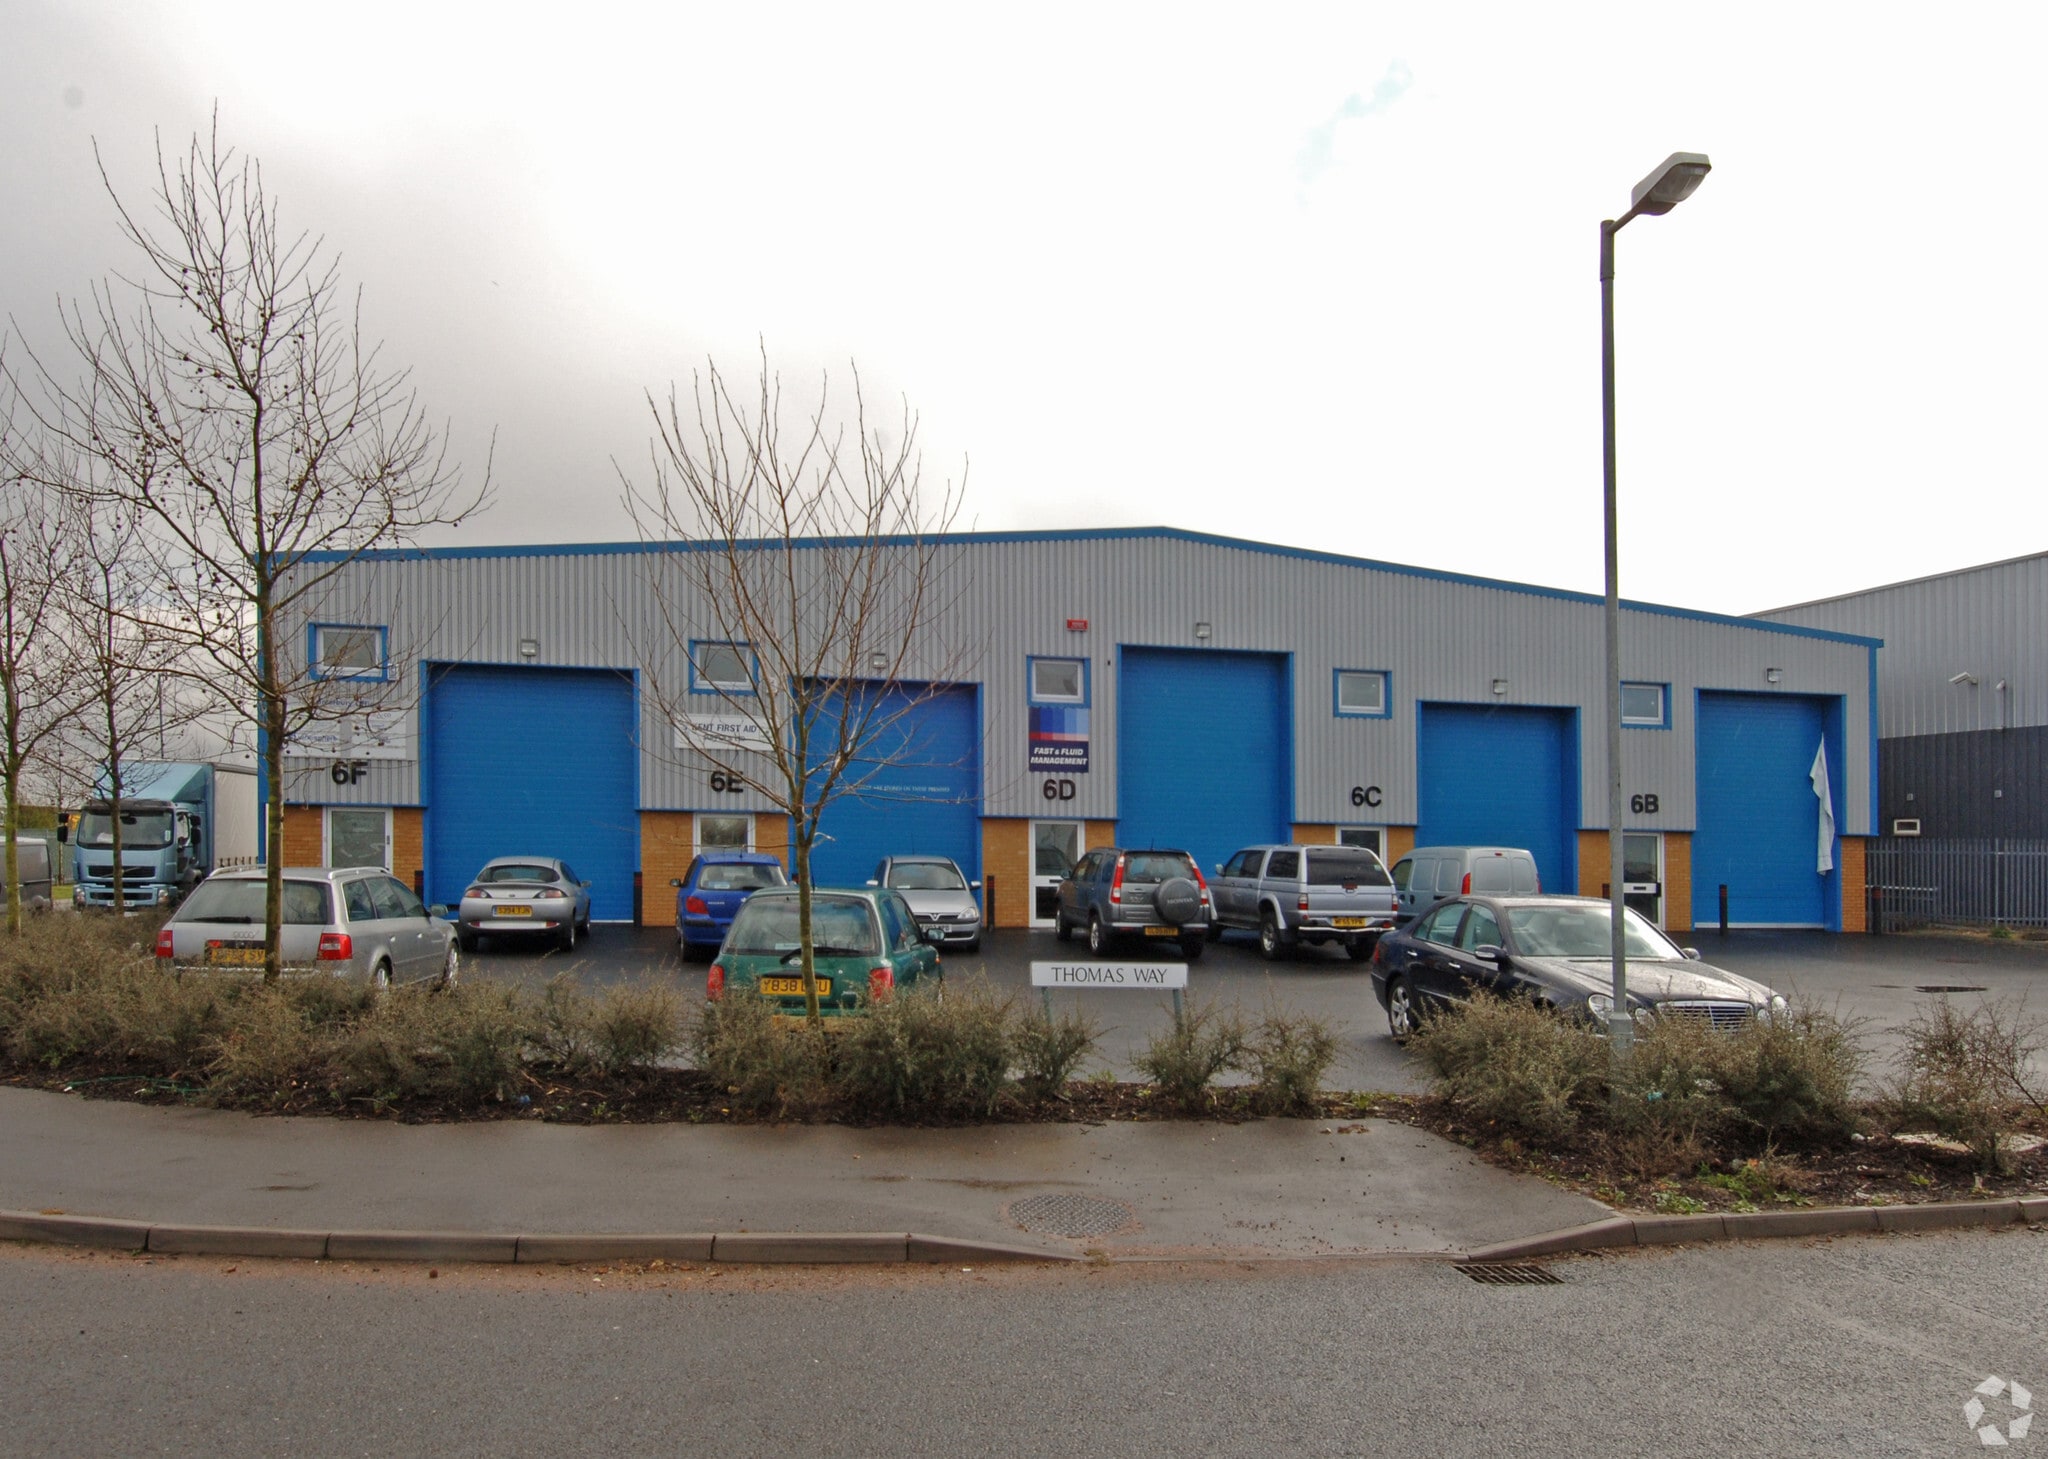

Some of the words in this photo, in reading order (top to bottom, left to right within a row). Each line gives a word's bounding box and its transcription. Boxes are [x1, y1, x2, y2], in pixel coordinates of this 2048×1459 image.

[716, 723, 741, 733] FIRST
[743, 724, 757, 733] AID
[1030, 756, 1088, 765] MANAGEMENT
[1034, 747, 1054, 755] FAST
[1061, 748, 1084, 756] FLUID
[332, 761, 368, 785] 6F
[710, 770, 744, 793] 6E
[1043, 778, 1076, 801] 6D
[1351, 785, 1382, 807] 6C
[1630, 794, 1659, 814] 6B
[1051, 967, 1124, 983] THOMAS
[1133, 968, 1168, 983] WAY
[763, 980, 798, 992] Y838
